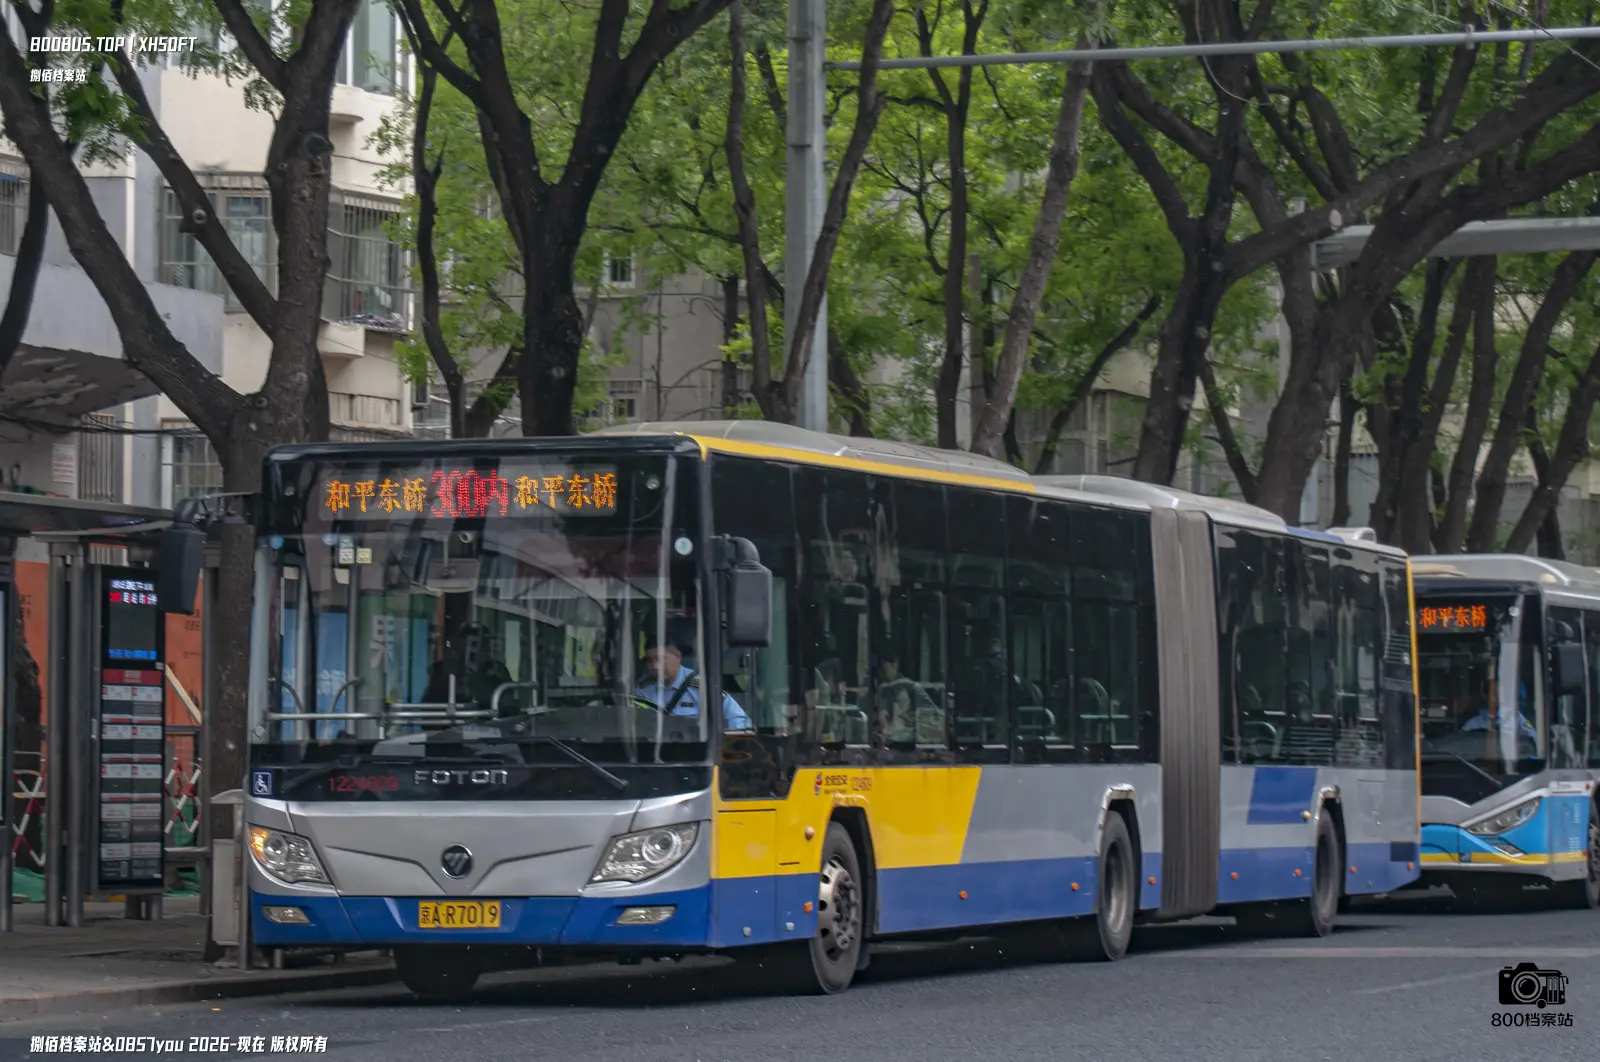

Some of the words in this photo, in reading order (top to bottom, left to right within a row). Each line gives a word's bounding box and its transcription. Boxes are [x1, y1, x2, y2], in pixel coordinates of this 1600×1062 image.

[325, 478, 428, 513] 和平东桥
[430, 469, 509, 517] 300内
[514, 472, 617, 510] 和平东桥
[1419, 605, 1486, 628] 和平东桥
[414, 769, 508, 785] FOTON
